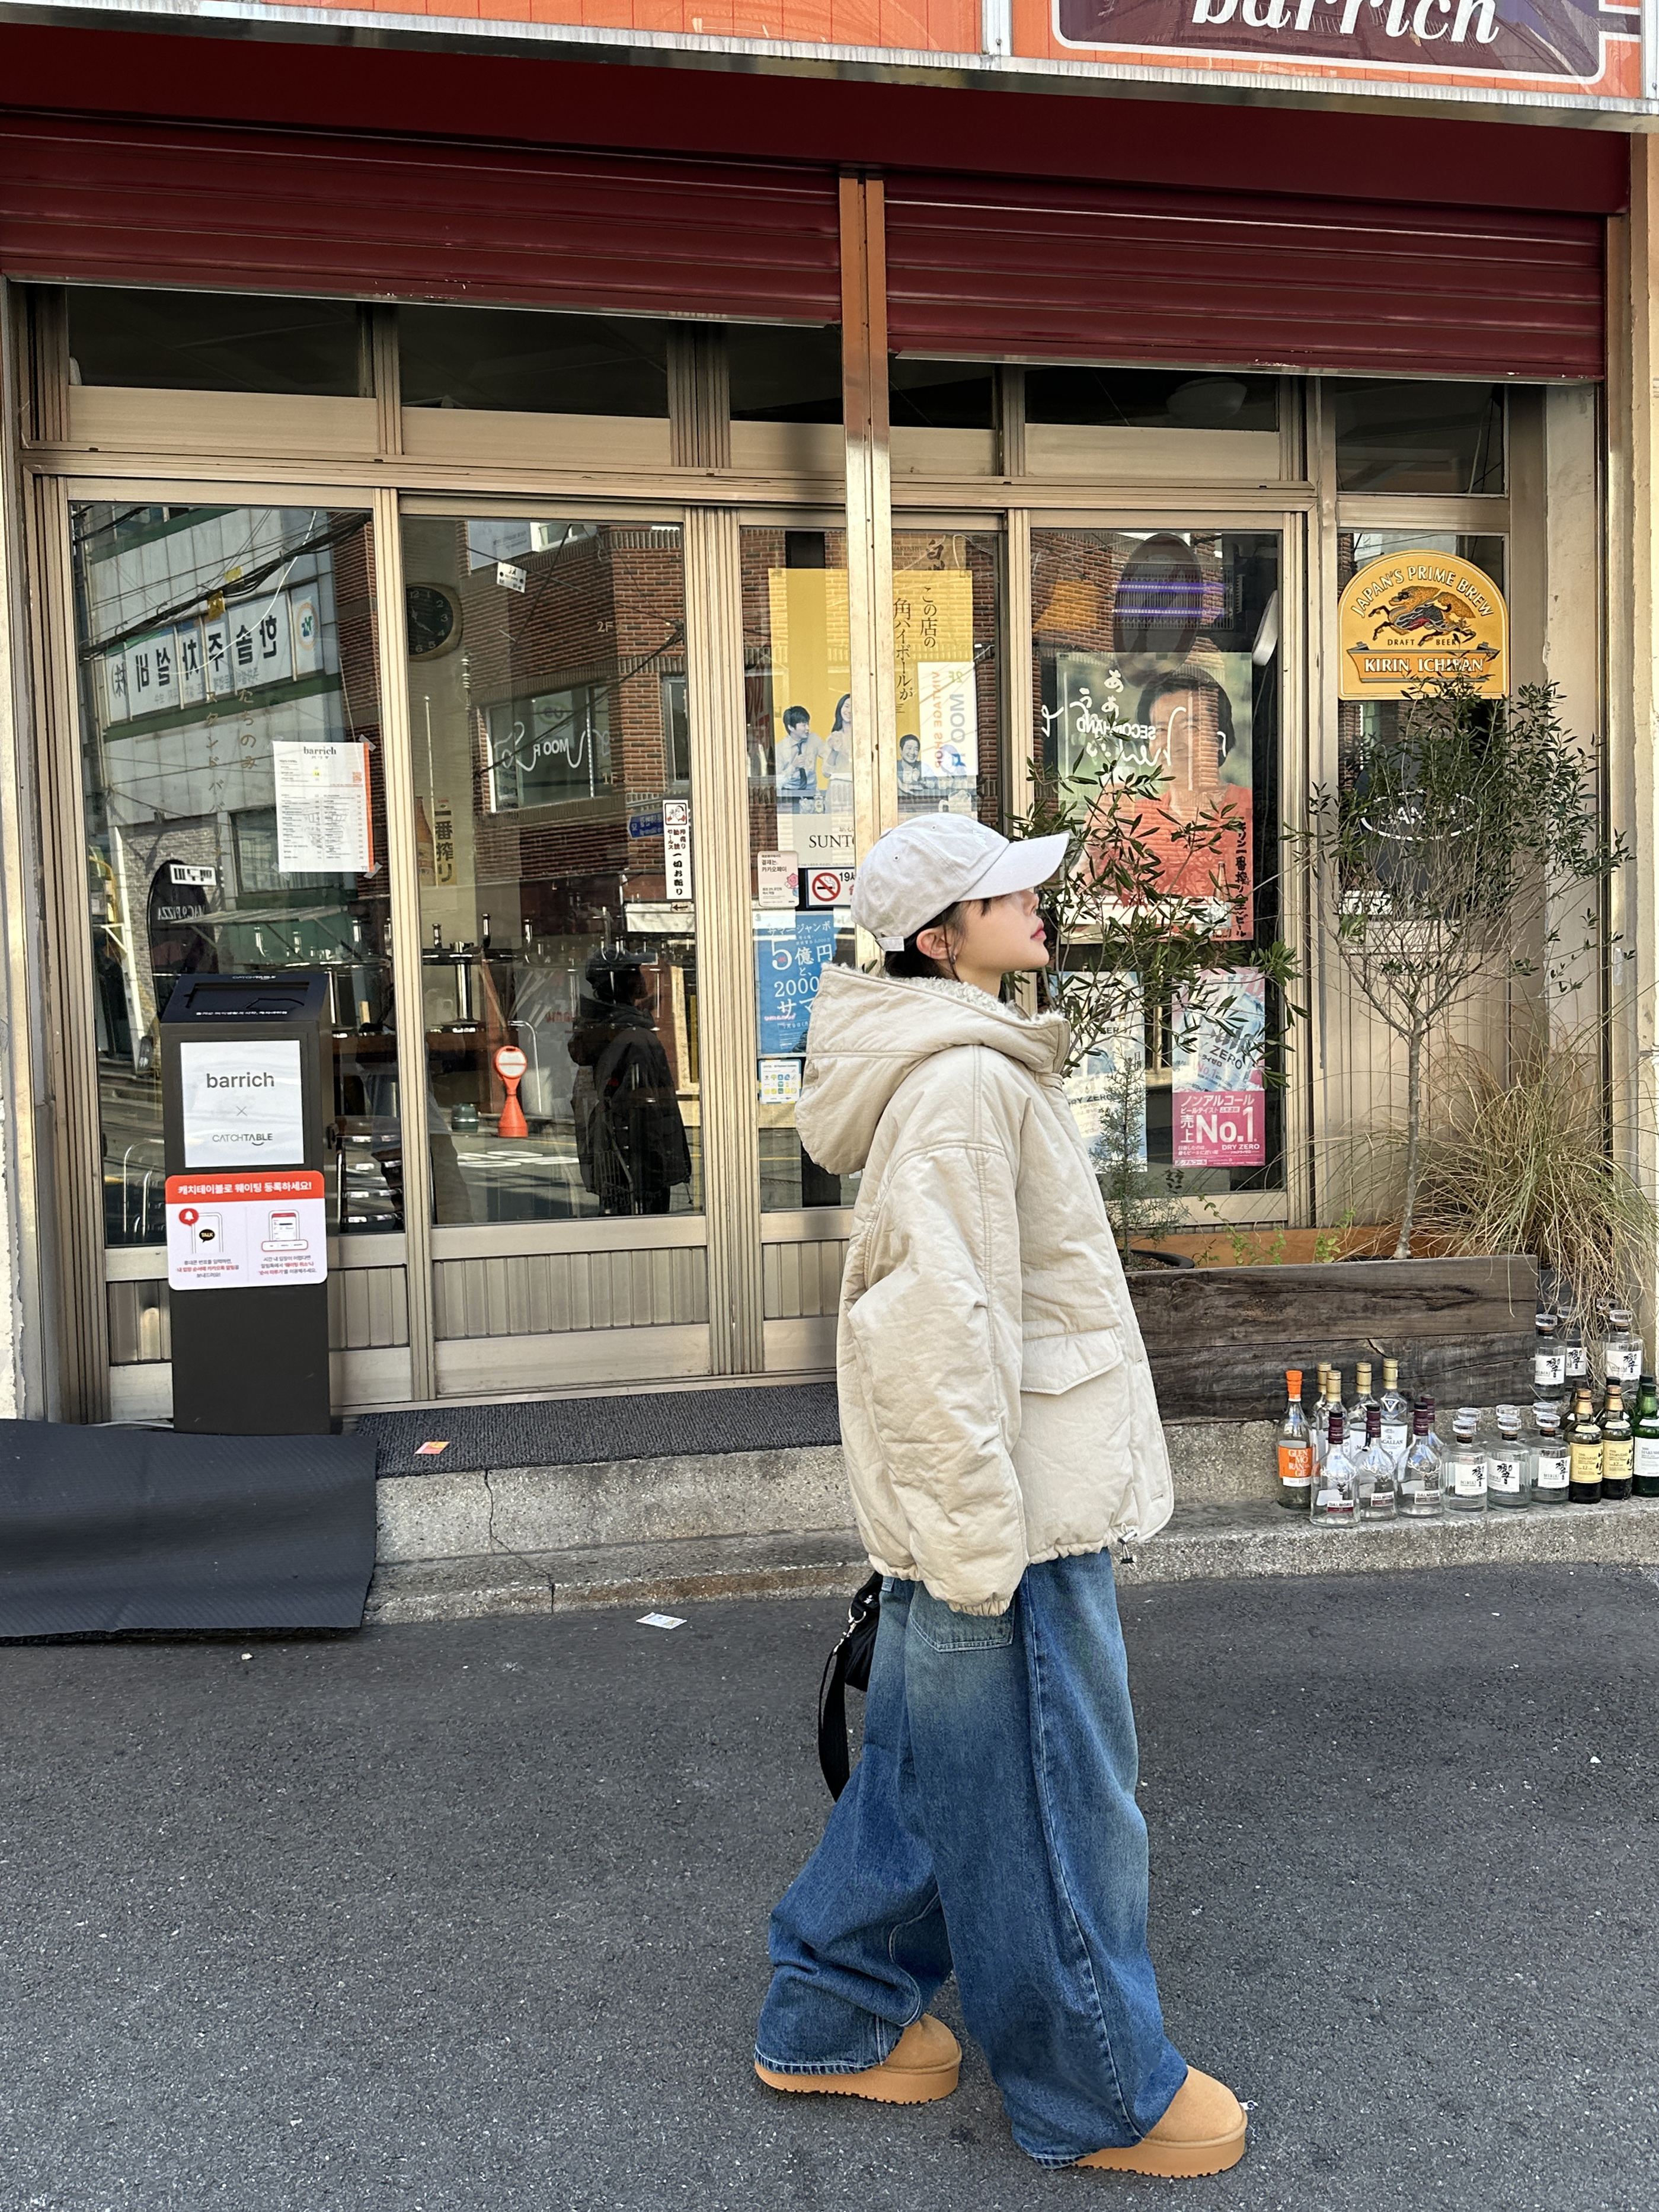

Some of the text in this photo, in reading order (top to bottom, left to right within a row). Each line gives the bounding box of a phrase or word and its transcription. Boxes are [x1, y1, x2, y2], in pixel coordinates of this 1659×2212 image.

[410, 590, 420, 599] 12
[1351, 565, 1494, 618] JAPAN'S PRIME BREW
[440, 614, 448, 622] 3
[920, 586, 938, 648] この店の
[597, 621, 613, 632] 2F
[893, 597, 913, 701] 角ハイボールが
[1364, 658, 1409, 672] KIRIN
[303, 746, 337, 756] barrich
[434, 810, 454, 882] 一番搾り
[808, 835, 855, 849] SUNT
[672, 852, 684, 896] 一切お断り
[1209, 1045, 1242, 1070] ZERO
[206, 1072, 274, 1088] barrich
[1180, 1094, 1255, 1107] ノンアルコール
[1180, 1106, 1254, 1143] 売上 No.1
[212, 1133, 273, 1143] CATCHTABLE
[178, 1181, 312, 1195] 캐치테이블로 웨이팅 등록하세요!
